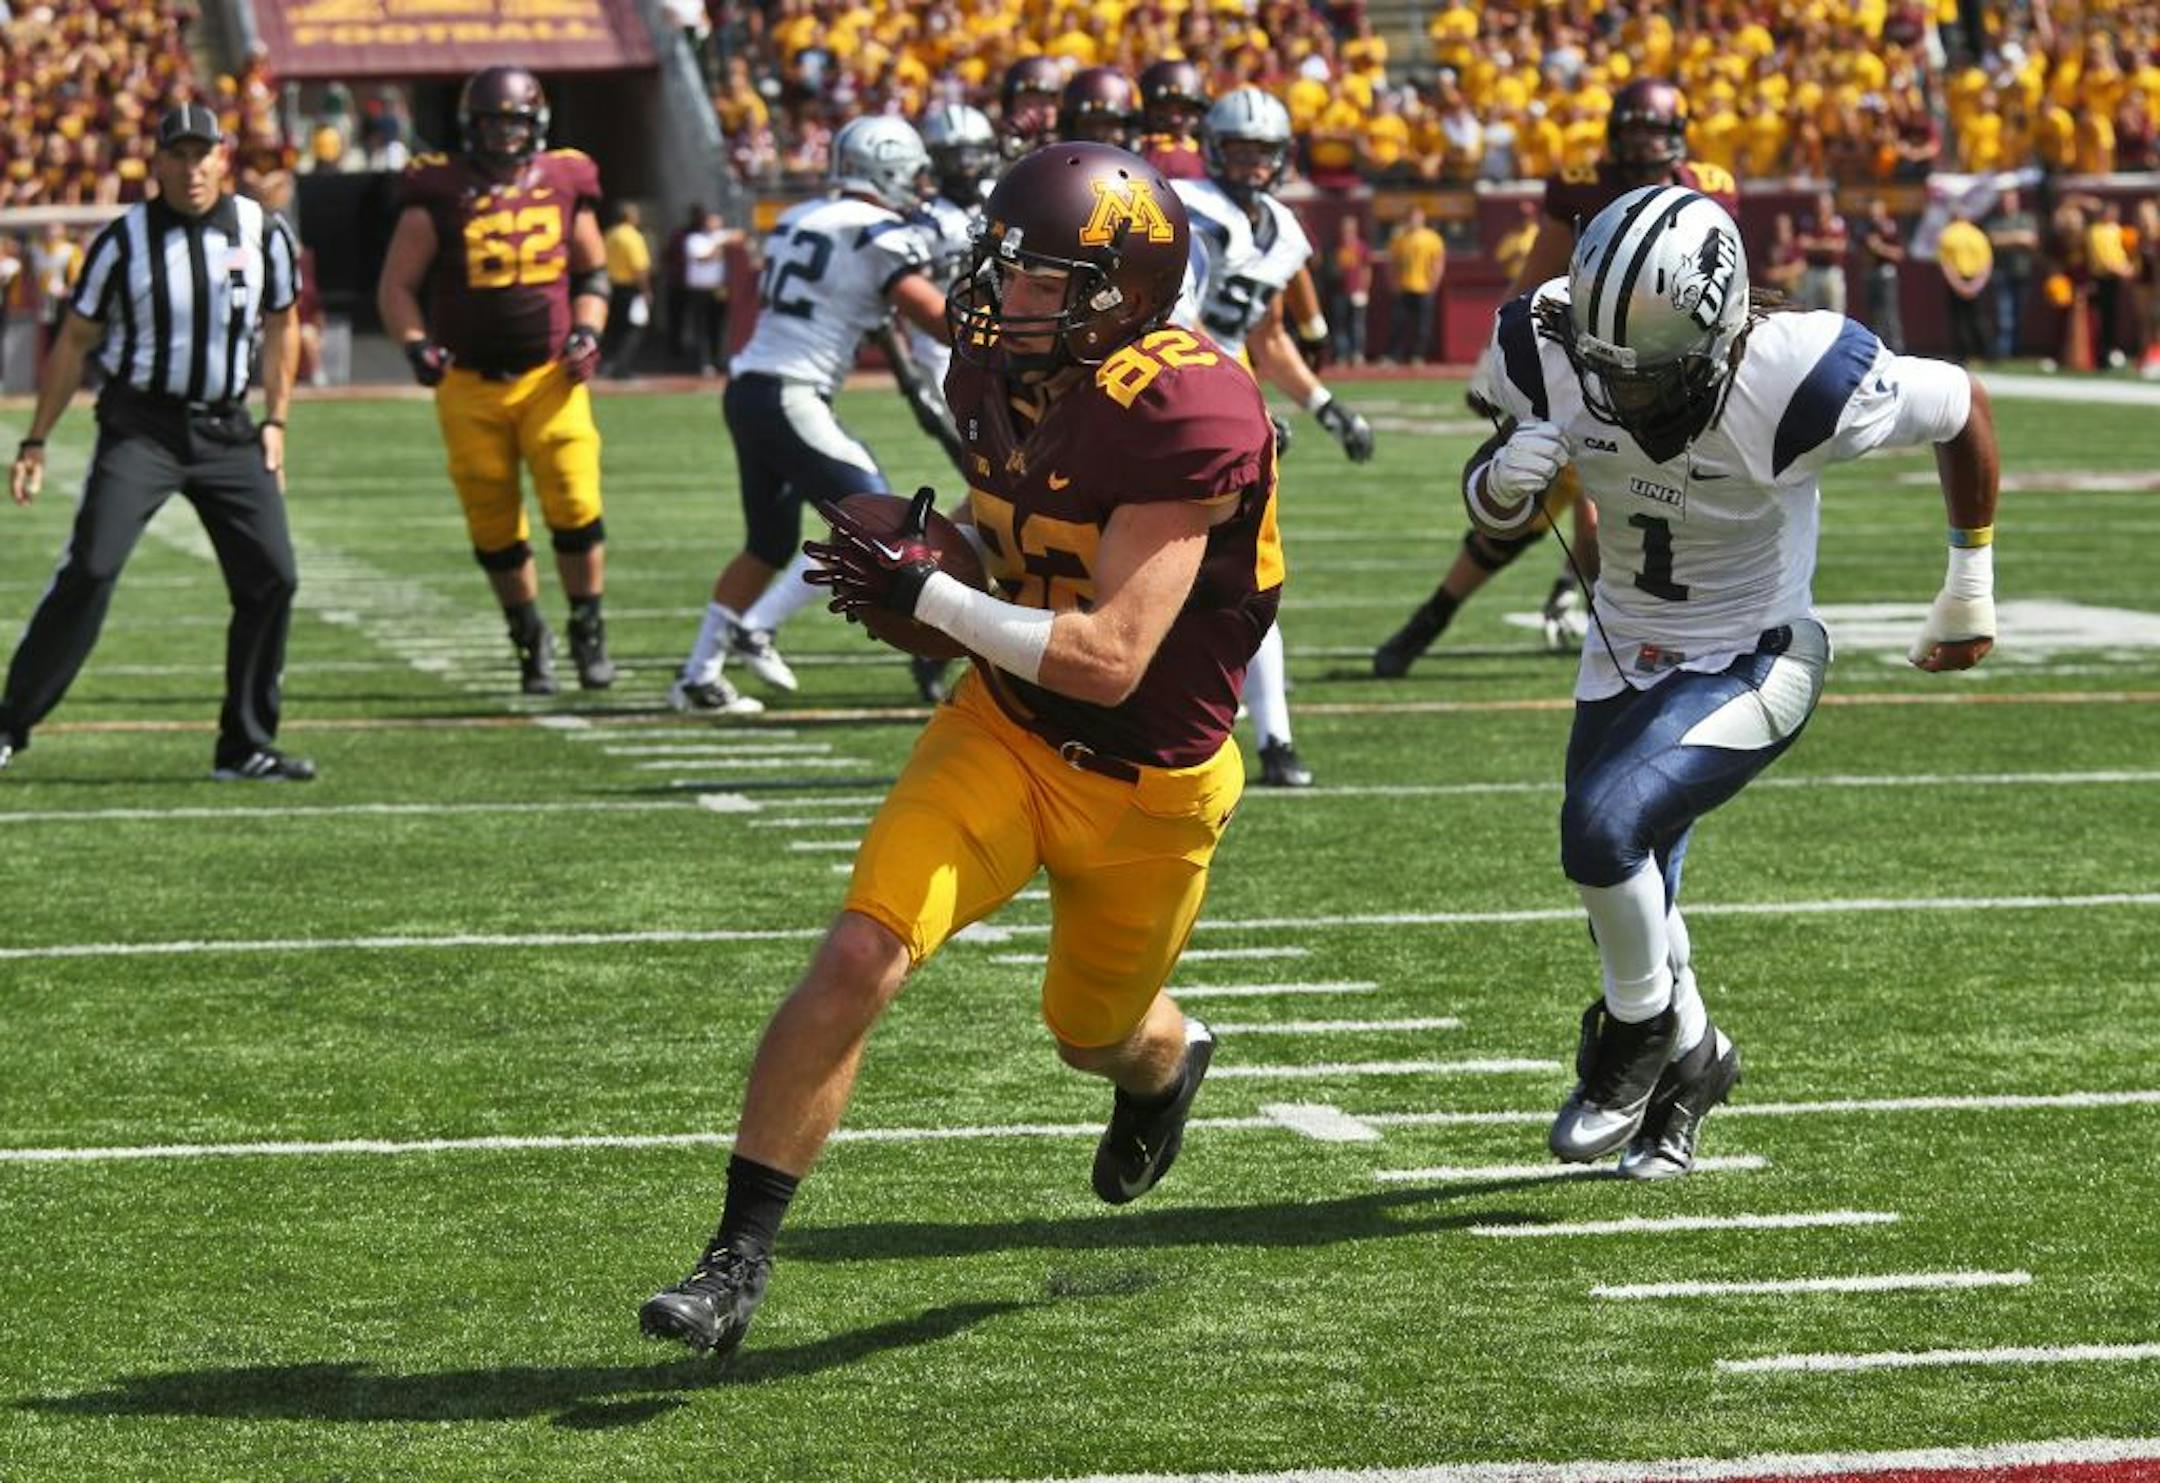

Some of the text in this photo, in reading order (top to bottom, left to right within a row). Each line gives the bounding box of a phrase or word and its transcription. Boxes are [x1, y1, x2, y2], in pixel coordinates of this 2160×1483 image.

[293, 19, 606, 46] FOOTBALL
[463, 204, 568, 288] 62
[1079, 178, 1174, 247] M
[1696, 228, 1737, 328] UNH
[1095, 329, 1219, 408] 82
[1584, 437, 1619, 453] CAA
[1630, 478, 1684, 507] UNH
[1628, 513, 1690, 602] 1
